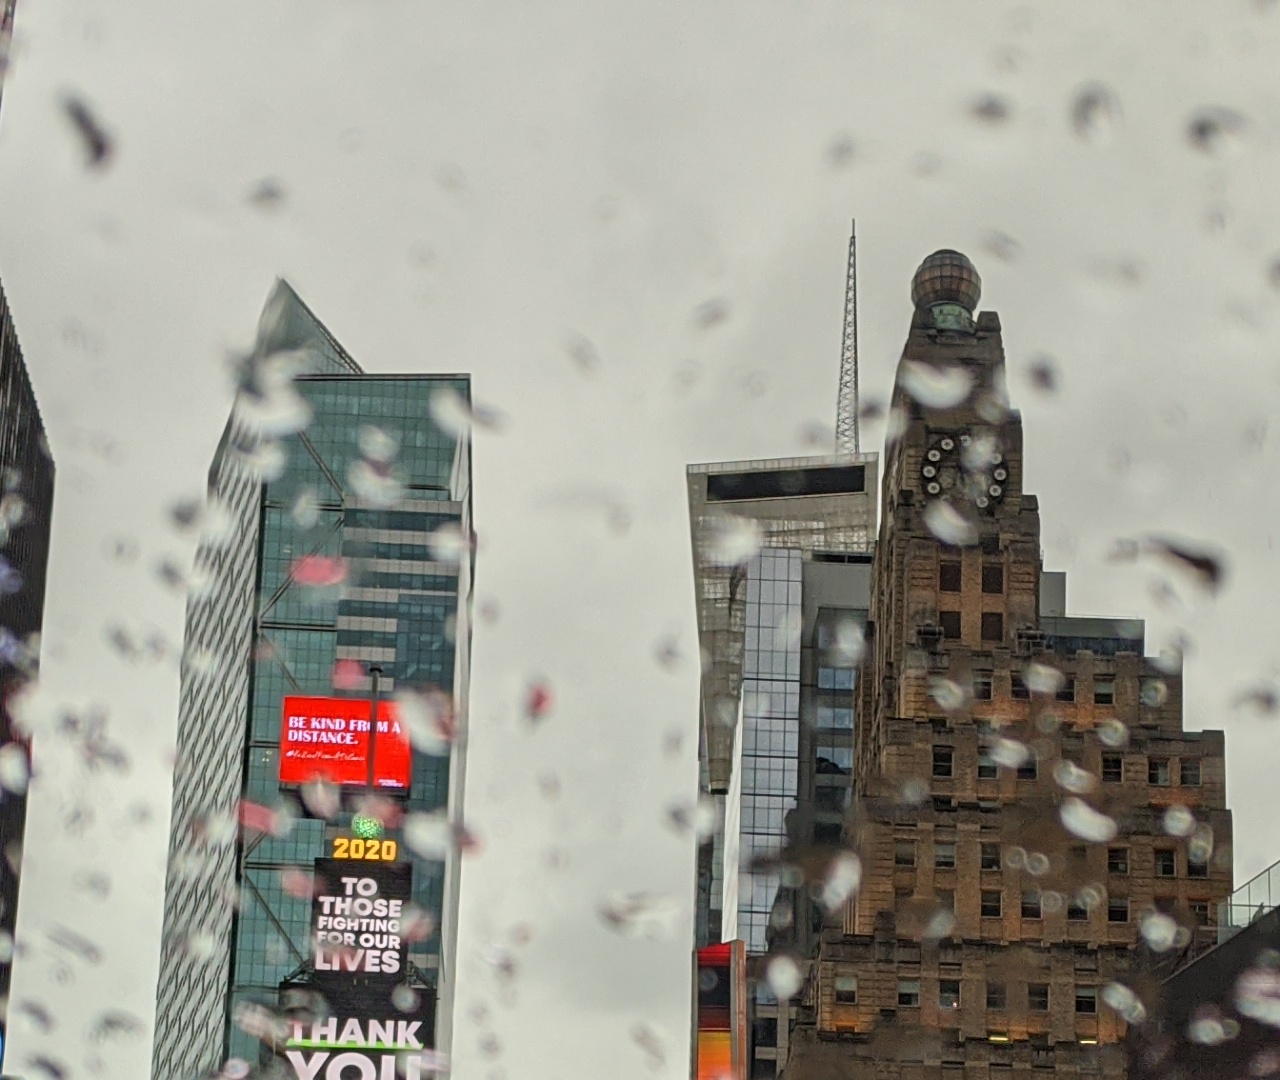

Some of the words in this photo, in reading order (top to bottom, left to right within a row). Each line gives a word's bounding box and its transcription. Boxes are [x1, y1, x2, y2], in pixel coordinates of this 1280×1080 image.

[288, 716, 308, 730] BE
[310, 717, 347, 732] KIND
[391, 721, 401, 735] A
[287, 729, 360, 746] DISTANCE.
[333, 838, 397, 862] 2020
[340, 877, 378, 897] TO
[318, 896, 403, 918] THOSE
[318, 916, 401, 934] FIGHTING
[316, 930, 356, 947] FOR
[358, 934, 402, 951] OUR
[314, 950, 401, 975] LIVES
[291, 1017, 423, 1048] THANK
